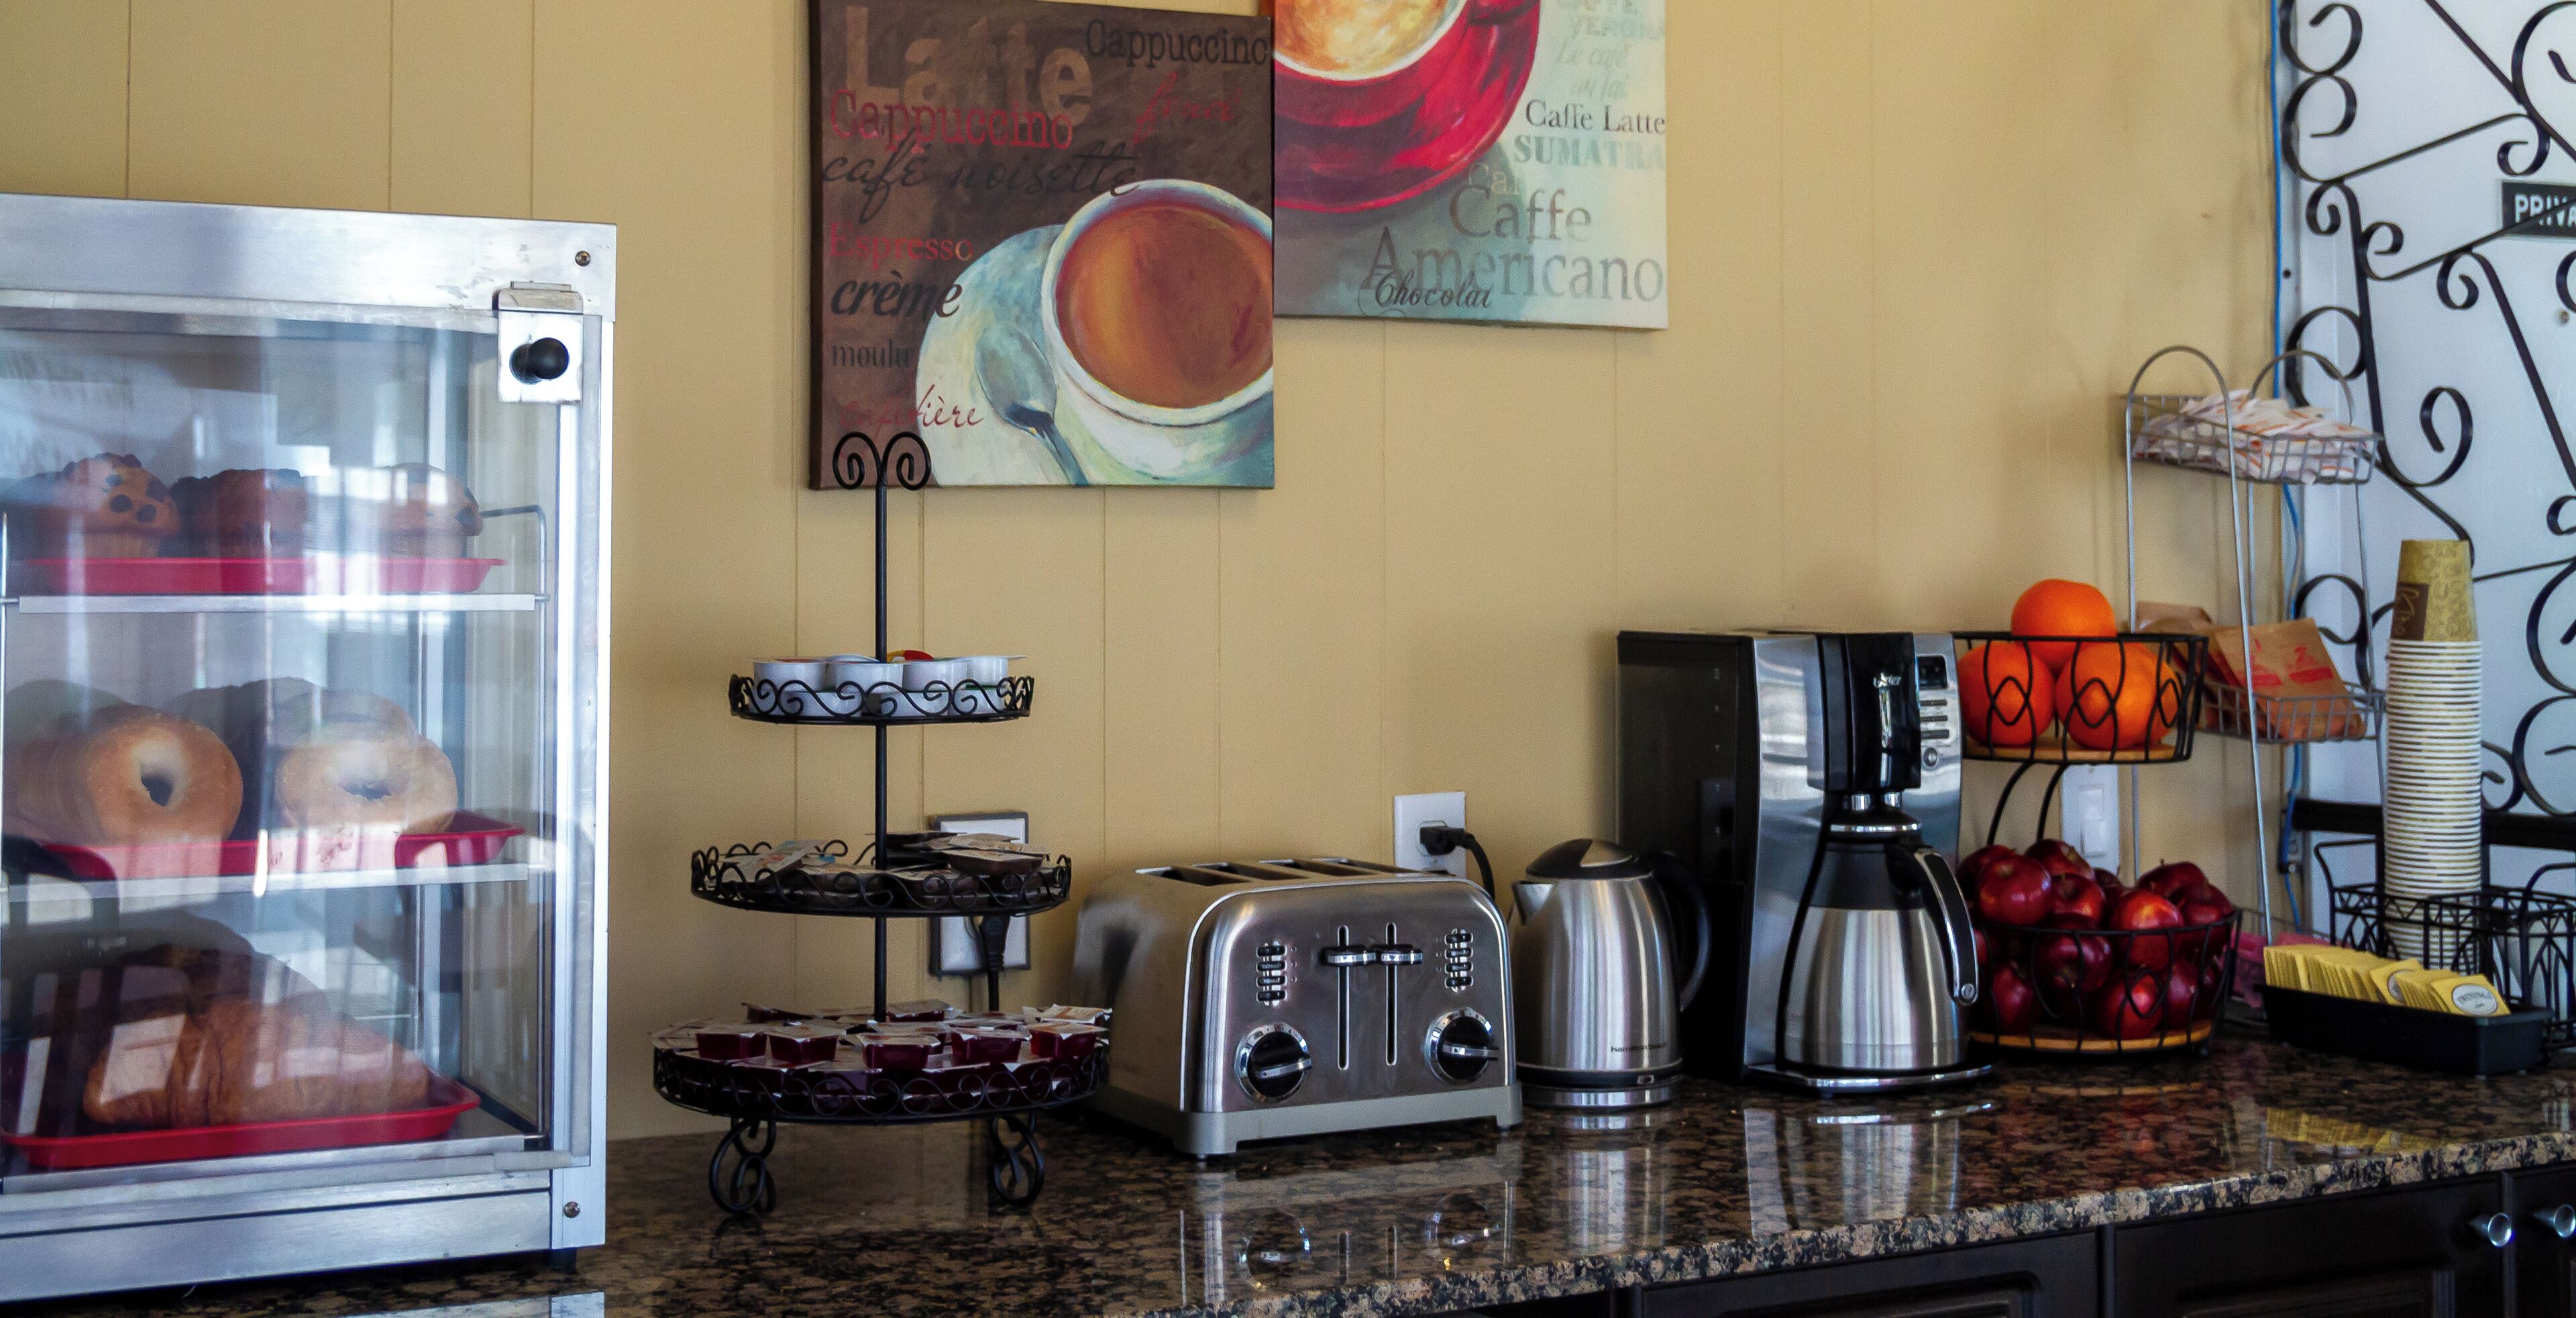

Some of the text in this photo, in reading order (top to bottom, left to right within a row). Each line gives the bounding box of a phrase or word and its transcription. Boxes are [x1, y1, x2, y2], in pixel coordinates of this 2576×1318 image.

[847, 5, 1093, 128] Latte
[1086, 19, 1269, 68] Cappuccino
[829, 89, 1073, 154] Cappuccino
[1525, 99, 1666, 134] Caffe Latte
[822, 128, 1140, 223] café noisette
[1513, 135, 1665, 170] SUMATRA
[1449, 185, 1592, 244] Caffe
[829, 223, 973, 270] Espresso
[1363, 225, 1664, 302] Americano
[830, 269, 963, 318] crème
[832, 340, 913, 368] moulu
